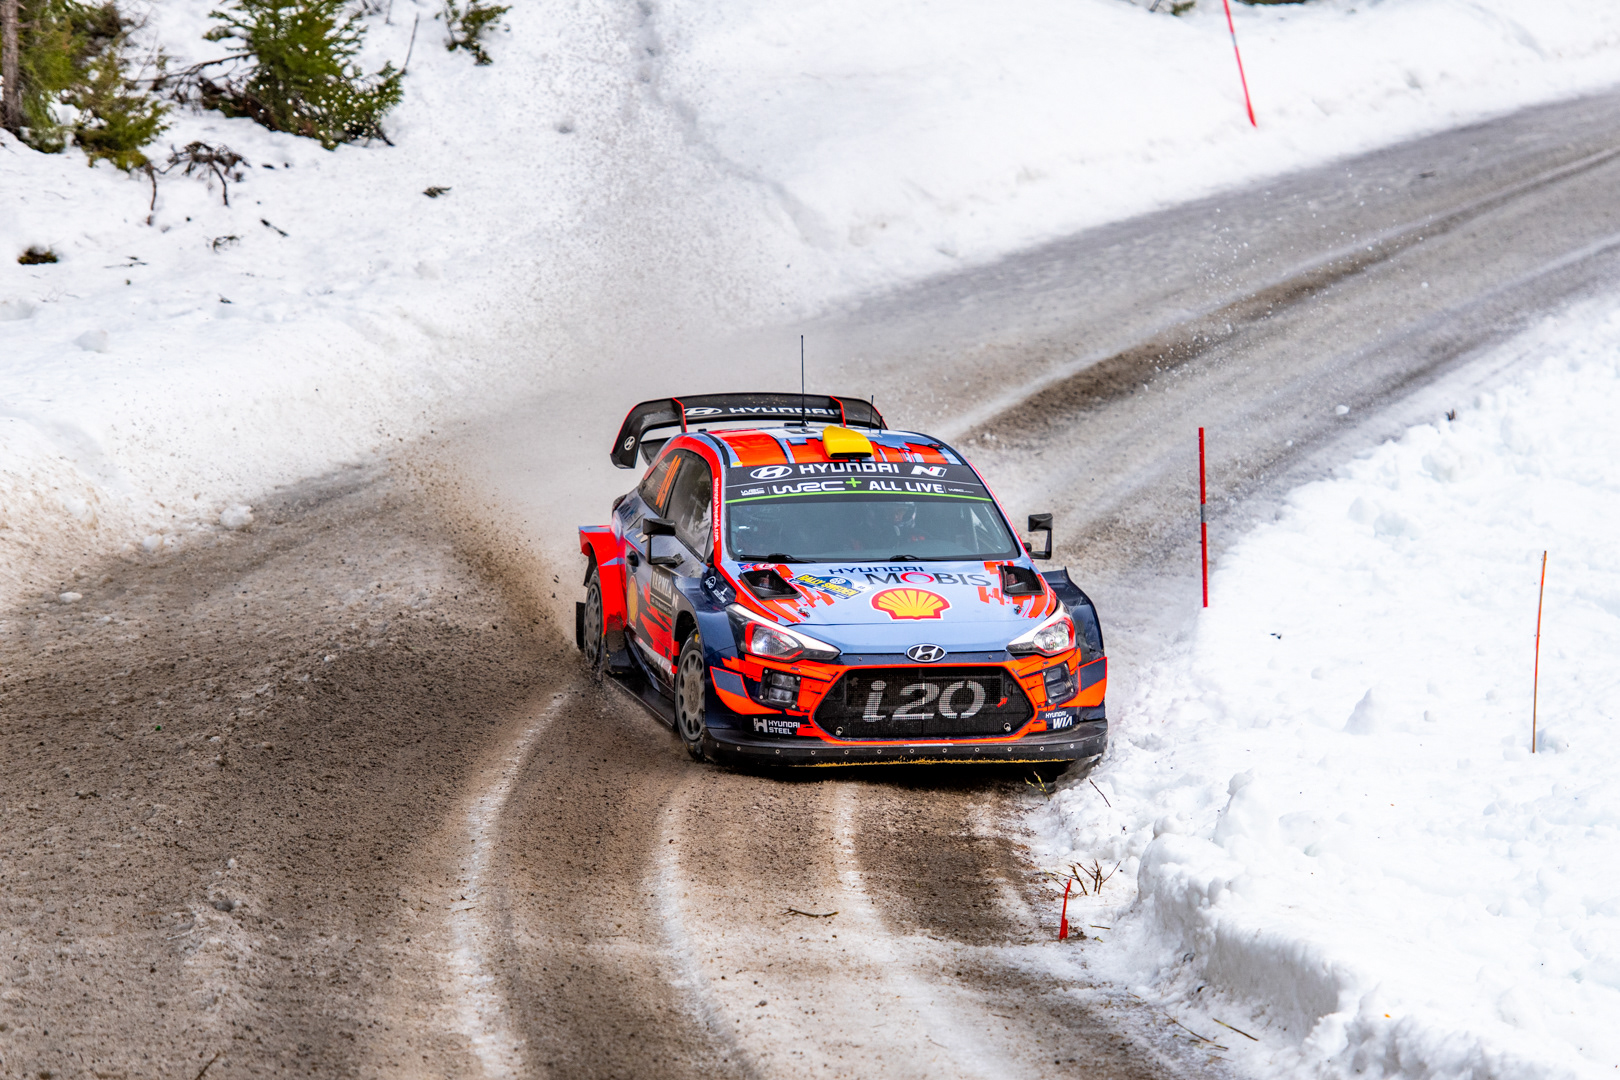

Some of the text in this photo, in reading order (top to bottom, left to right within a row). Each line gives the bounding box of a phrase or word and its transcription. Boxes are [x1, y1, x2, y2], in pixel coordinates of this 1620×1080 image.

[729, 407, 836, 416] HYUNDAI
[799, 463, 900, 475] HYUNDAI
[869, 480, 902, 492] ALL
[905, 481, 945, 494] LIVE
[829, 567, 924, 575] HYUNDAI
[866, 572, 992, 587] MOBIS
[796, 574, 827, 586] RALLY
[821, 582, 861, 597] SWEDEN
[862, 680, 986, 723] i20
[1045, 710, 1067, 719] HYUNDAI
[768, 720, 800, 728] HYUNDAI
[768, 726, 793, 735] STEEL
